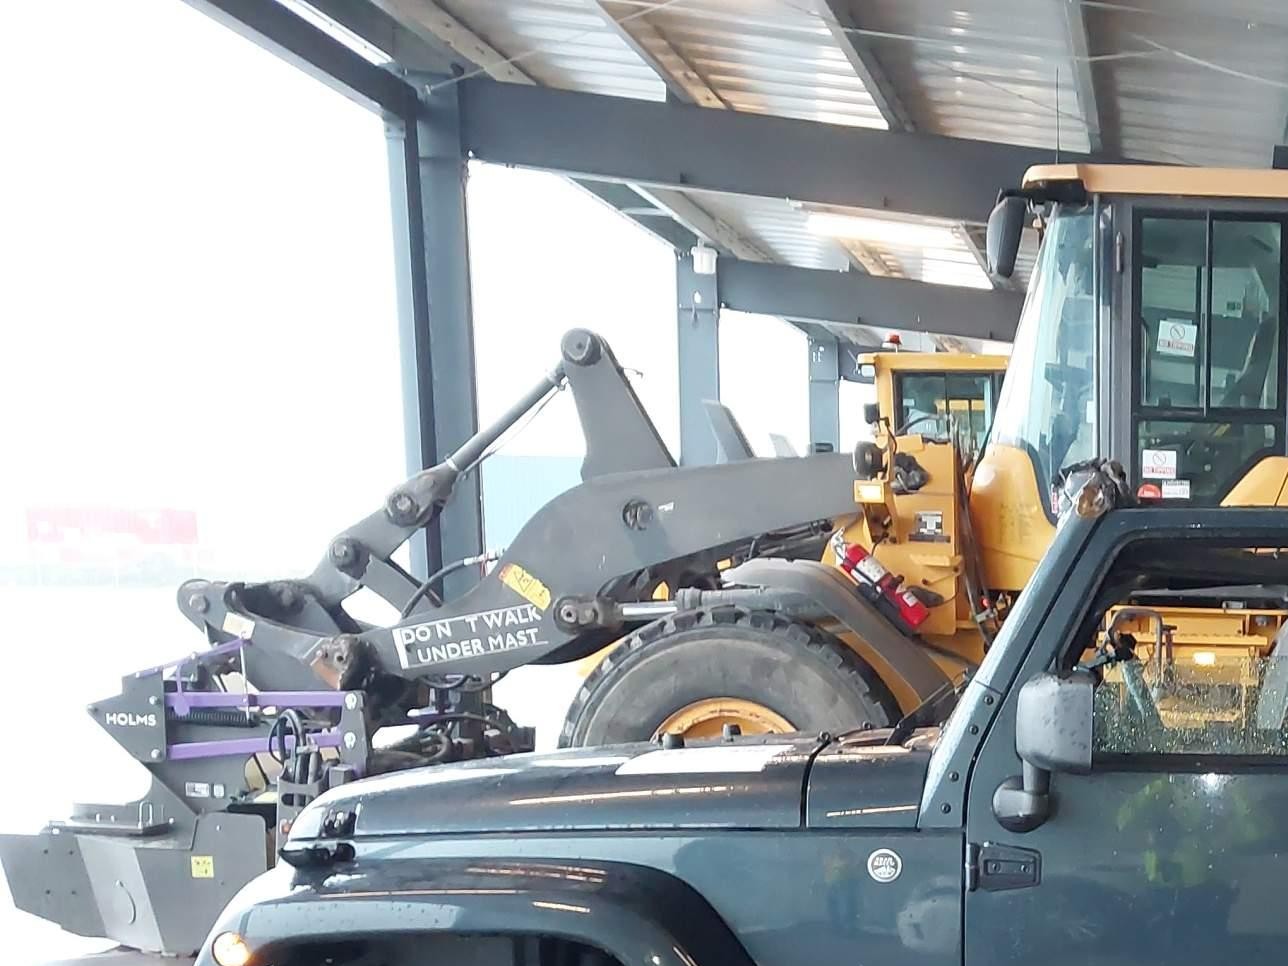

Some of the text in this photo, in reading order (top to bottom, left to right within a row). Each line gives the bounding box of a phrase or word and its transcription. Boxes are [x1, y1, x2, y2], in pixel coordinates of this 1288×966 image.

[482, 605, 542, 630] WALK
[416, 627, 539, 664] UNDER MAST
[105, 712, 157, 727] HOLMS
